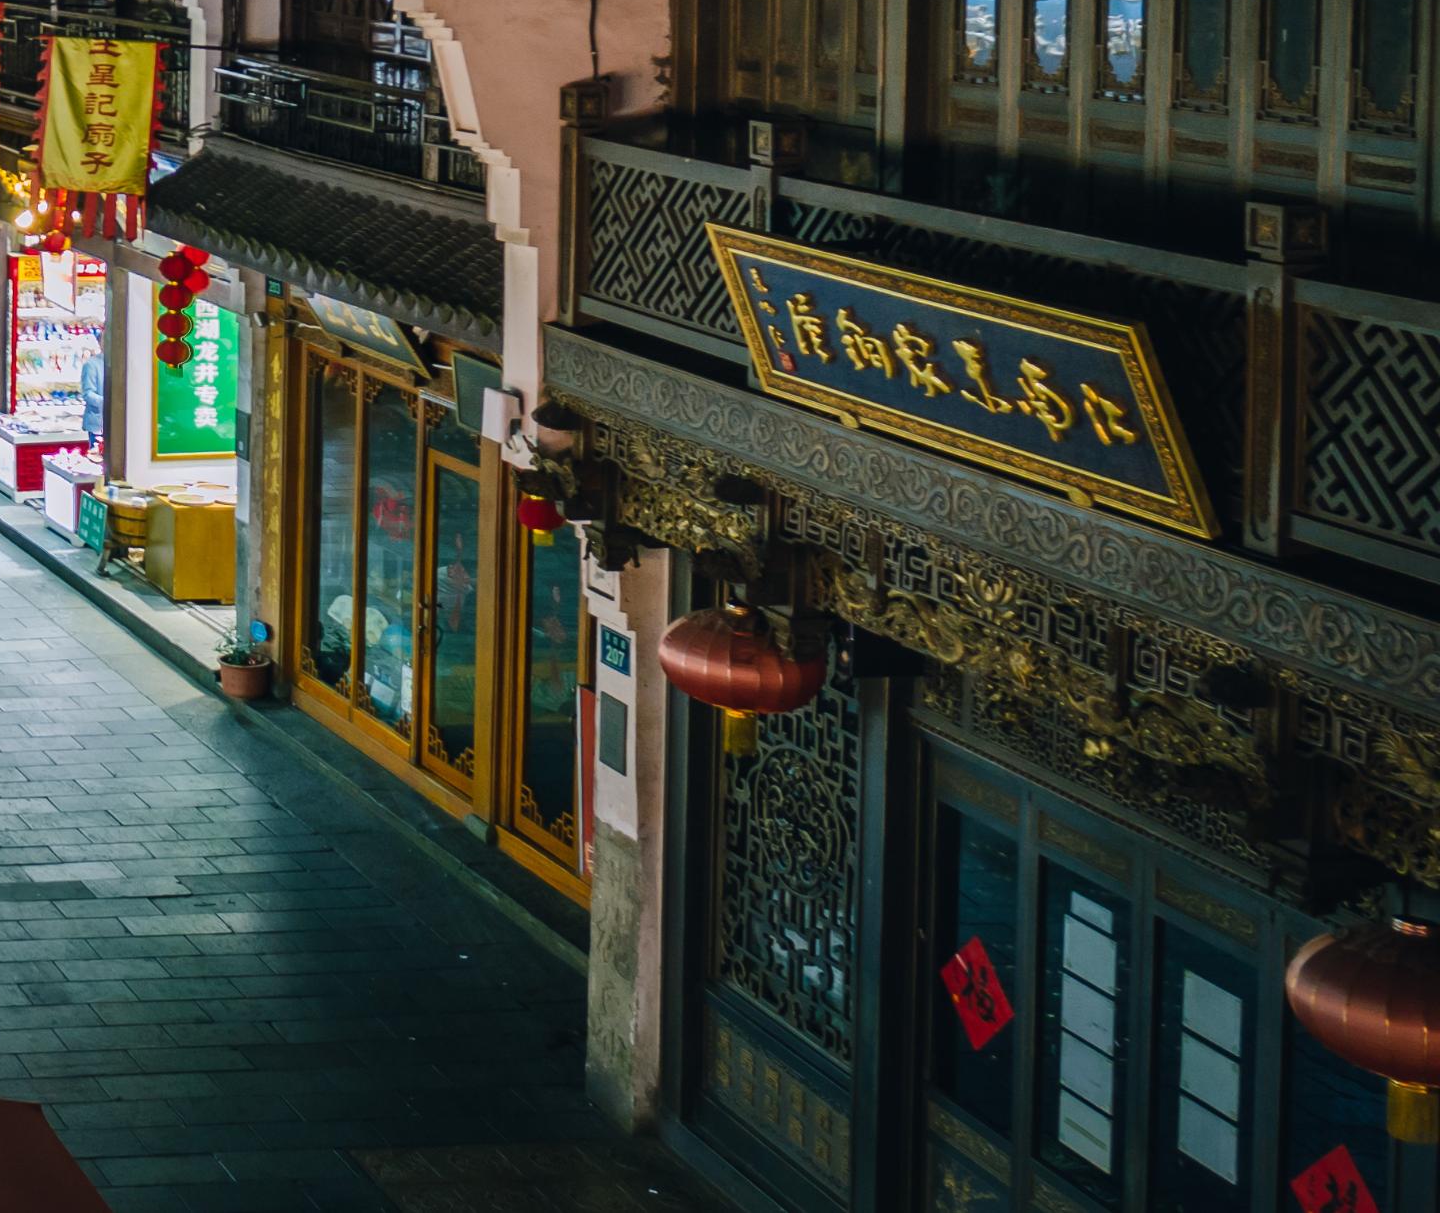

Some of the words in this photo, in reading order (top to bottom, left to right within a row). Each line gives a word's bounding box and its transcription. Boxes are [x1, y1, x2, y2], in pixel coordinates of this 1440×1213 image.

[194, 299, 220, 428] 西湖龙井专卖
[606, 645, 625, 667] 207
